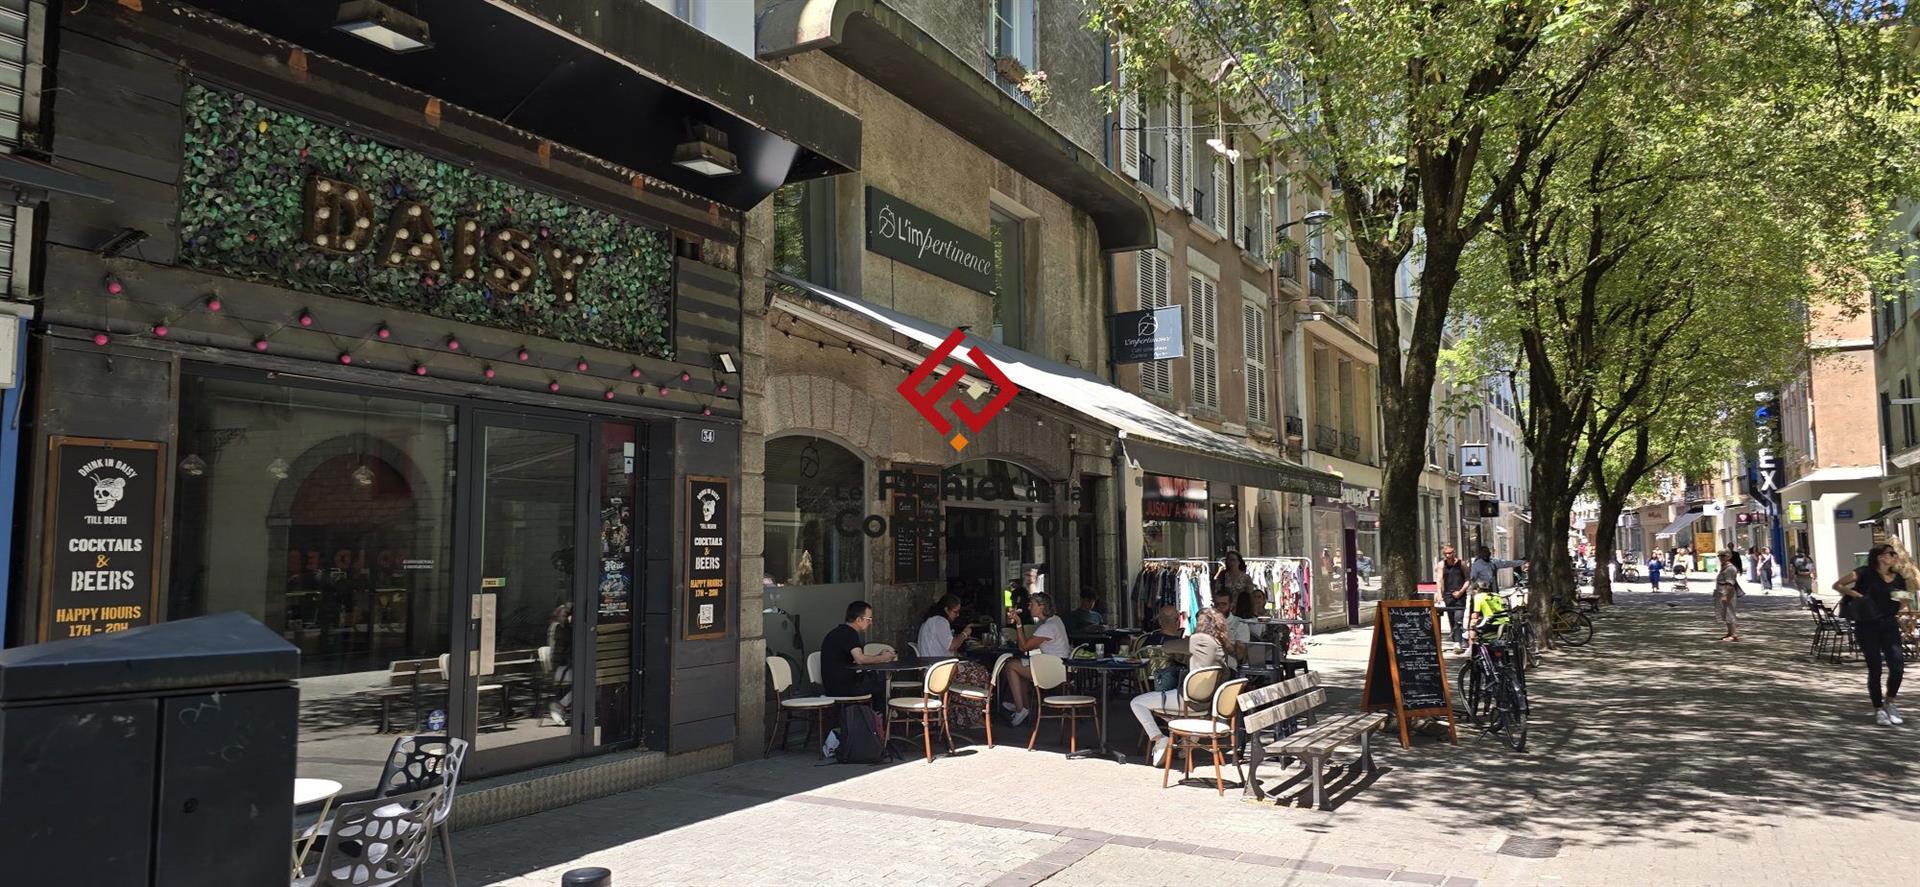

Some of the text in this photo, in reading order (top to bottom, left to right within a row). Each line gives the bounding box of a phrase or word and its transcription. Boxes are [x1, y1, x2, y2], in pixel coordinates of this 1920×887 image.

[303, 174, 591, 303] DAISY
[898, 216, 991, 276] L'impertinence
[703, 431, 713, 441] 34
[78, 458, 138, 479] DRINK IN DAISY
[104, 516, 127, 525] DEATH
[69, 538, 143, 552] COCKTAILS
[694, 537, 723, 546] COCKTAILS
[96, 554, 110, 568] &
[695, 557, 720, 570] BEERS
[71, 570, 135, 591] BEERS
[690, 579, 706, 588] HAPPY
[56, 605, 142, 622] HAPPY HOURS
[69, 624, 91, 637] 17H
[105, 622, 129, 633] 20H
